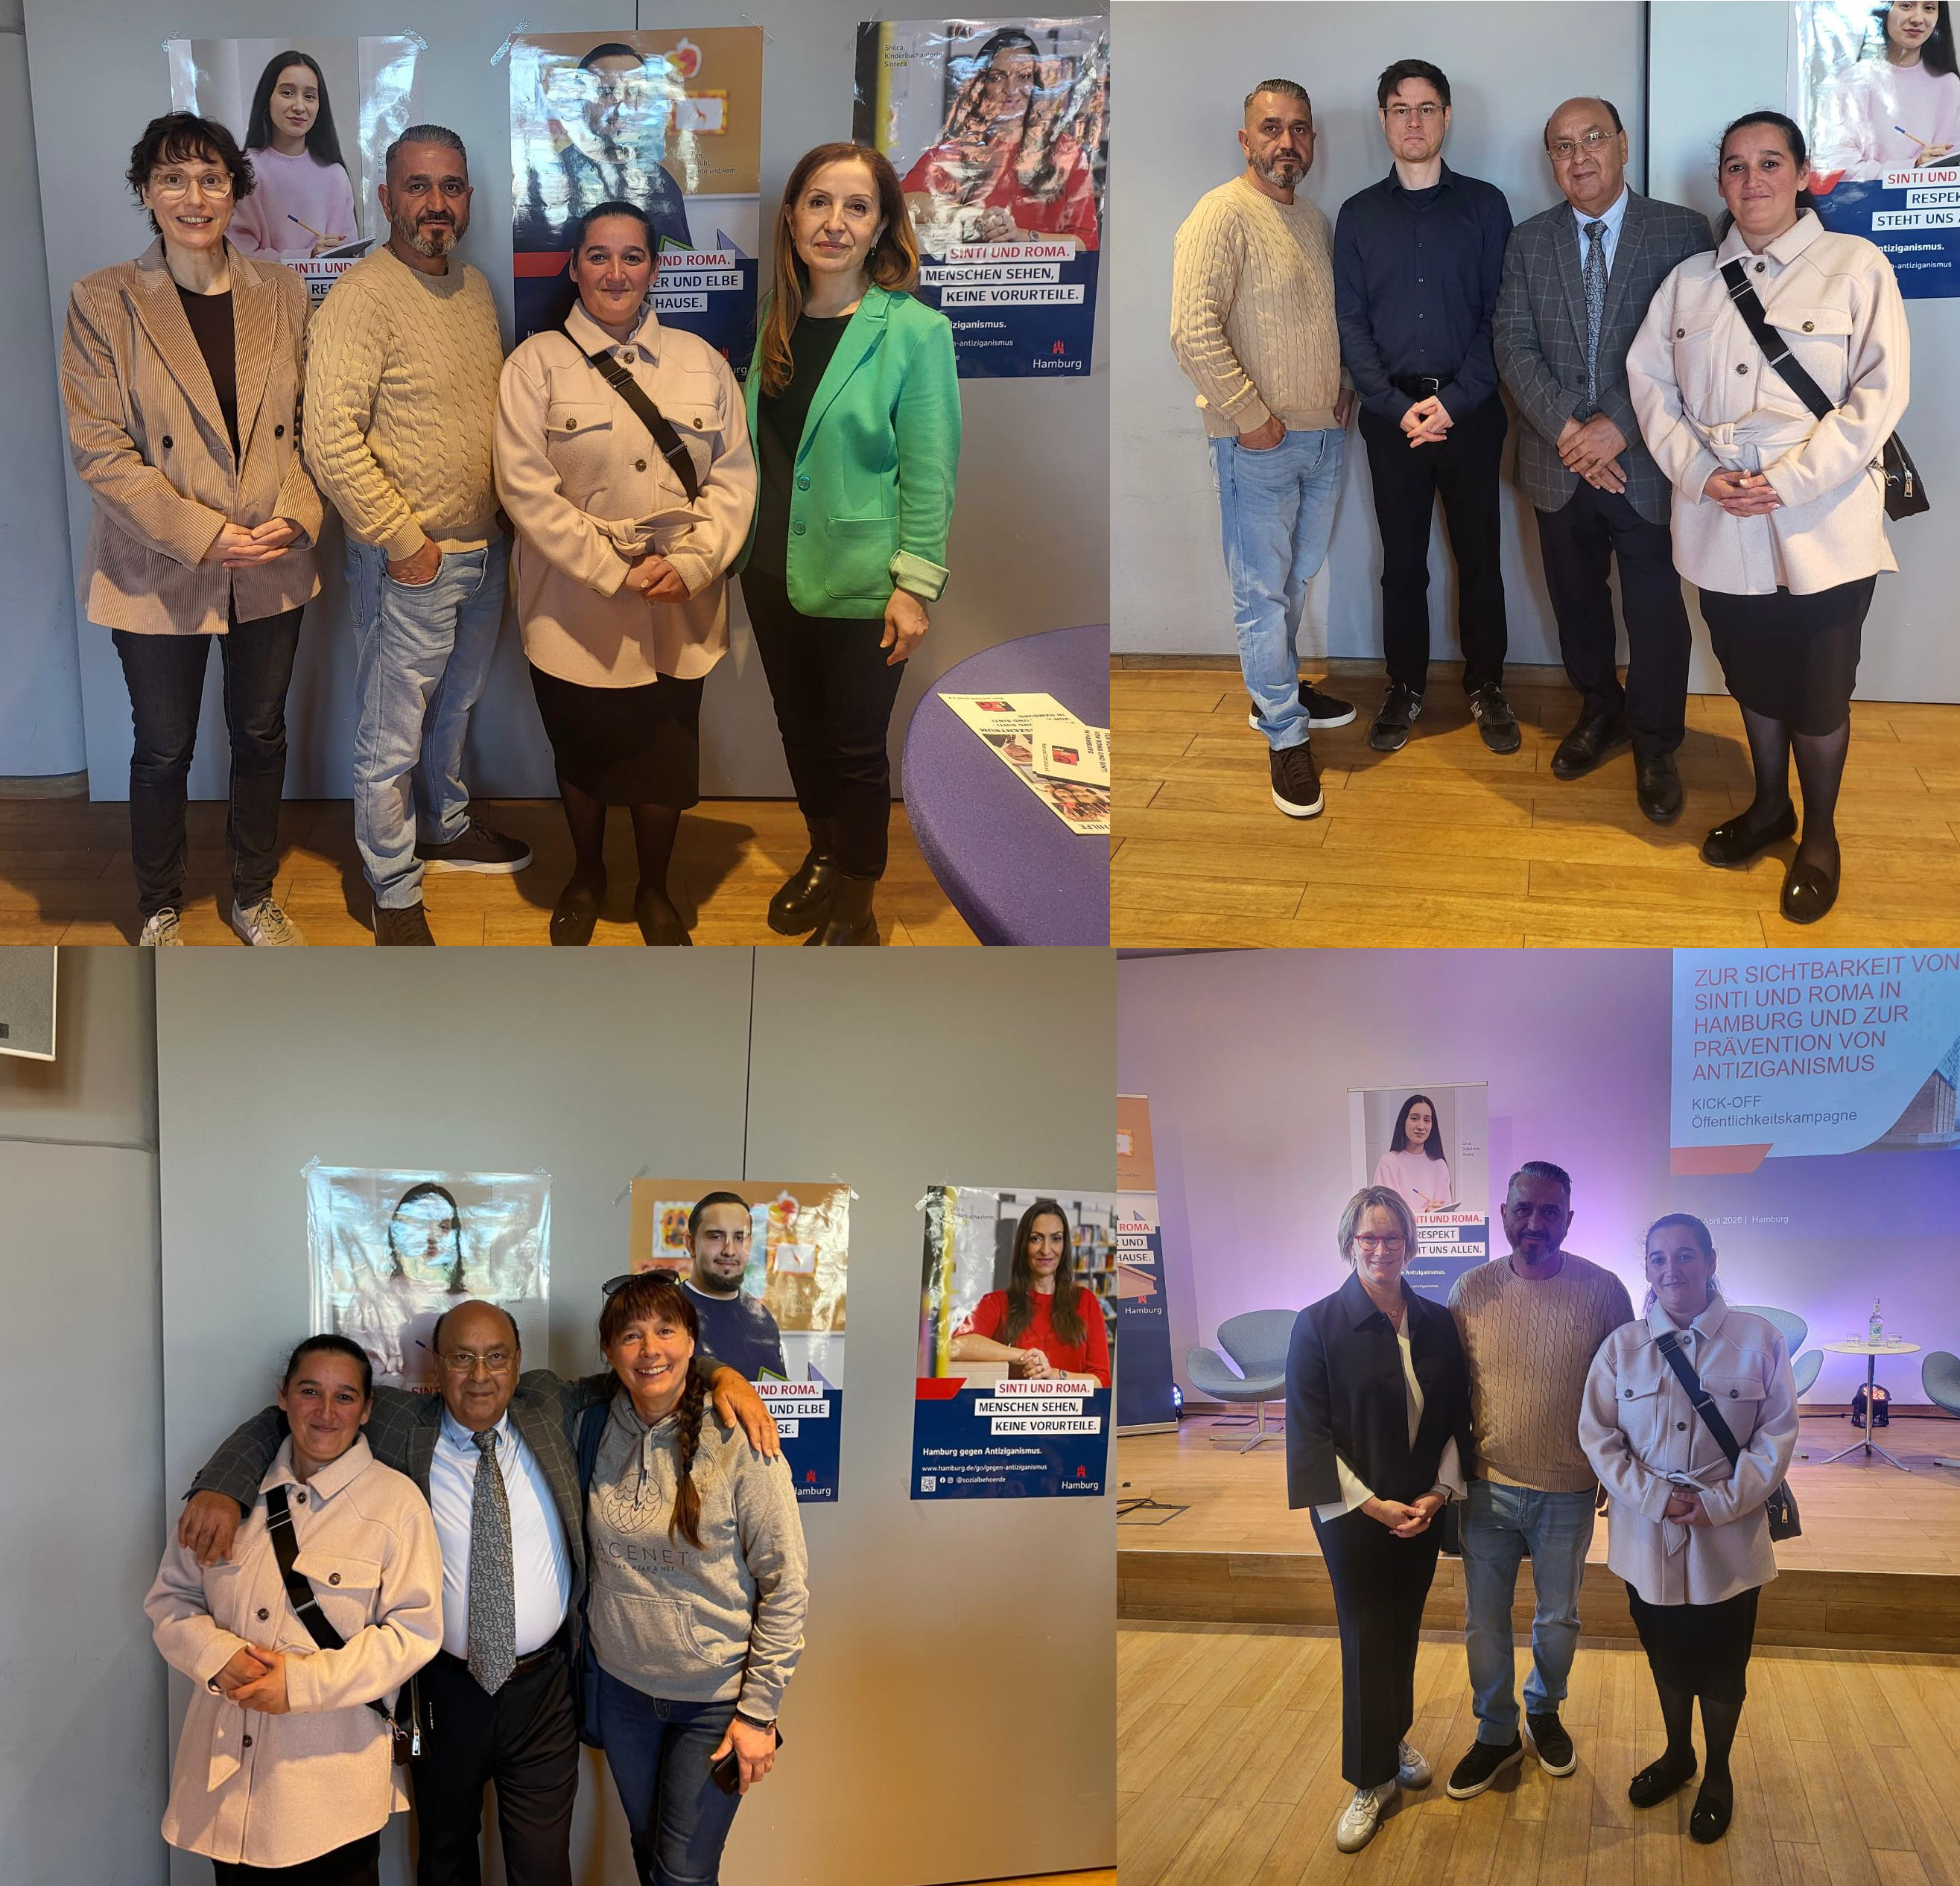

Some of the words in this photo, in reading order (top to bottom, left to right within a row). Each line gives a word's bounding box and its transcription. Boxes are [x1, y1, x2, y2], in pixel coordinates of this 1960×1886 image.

[1887, 172, 1923, 185] SINTI
[1927, 171, 1958, 182] UND
[1877, 214, 1922, 226] STEHT
[1925, 212, 1955, 225] UNS
[950, 247, 986, 259] SINTI
[991, 247, 1021, 258] UND
[1024, 245, 1071, 258] ROMA.
[686, 254, 731, 266] ROMA.
[925, 268, 1002, 282] MENSCHEN
[1006, 267, 1056, 282] SEHEN,
[673, 276, 703, 288] UND
[706, 275, 739, 287] ELBE
[945, 290, 986, 303] KEINE
[991, 288, 1079, 302] VORURTEILE.
[655, 297, 703, 308] HAUSE.
[1032, 358, 1082, 371] Hamburg
[1693, 968, 1739, 988] ZUR
[1744, 955, 1906, 985] SICHTBARKEIT
[1911, 952, 1960, 974] VON
[1694, 990, 1748, 1012] SINTI
[1755, 986, 1802, 1008] UND
[1808, 983, 1874, 1004] ROMA
[1880, 980, 1902, 1000] IN
[1693, 1011, 1804, 1035] HAMBURG
[1810, 1007, 1857, 1028] UND
[1862, 1004, 1909, 1026] ZUR
[1693, 1033, 1833, 1058] PRÄVENTION
[1837, 1029, 1886, 1050] VON
[1692, 1053, 1876, 1082] ANTIZIGANISMUS
[1692, 1095, 1763, 1111] KICK-OFF
[1691, 1111, 1858, 1128] Öffentlichkeitskampagne
[1430, 1215, 1450, 1223] UND
[1452, 1213, 1482, 1223] ROMA.
[1702, 1216, 1721, 1225] April
[1722, 1216, 1742, 1225] 2026
[1751, 1216, 1789, 1225] Hamburg
[1119, 1223, 1153, 1231] ROMA.
[1121, 1239, 1144, 1247] UND
[1430, 1245, 1448, 1254] UNS
[1450, 1245, 1482, 1254] ALLEN.
[1125, 1306, 1163, 1315] Hamburg
[781, 1385, 819, 1395] ROMA.
[998, 1383, 1027, 1393] SINTI
[1030, 1383, 1053, 1393] UND
[1056, 1383, 1090, 1393] ROMA.
[770, 1404, 795, 1414] UND
[798, 1404, 825, 1414] ELBE
[979, 1402, 1039, 1412] MENSCHEN
[1041, 1402, 1079, 1413] SEHEN,
[995, 1421, 1027, 1431] KEINE
[1030, 1420, 1097, 1431] VORURTEILE.
[922, 1447, 958, 1457] Hamburg
[959, 1448, 983, 1457] gegen
[983, 1447, 1042, 1456] Antiziganismus.
[922, 1463, 1047, 1473] www.hamburg.de/go/gegen-antiziganismus
[956, 1476, 1006, 1484] @sozialbehoerde
[1061, 1480, 1099, 1490] Hamburg
